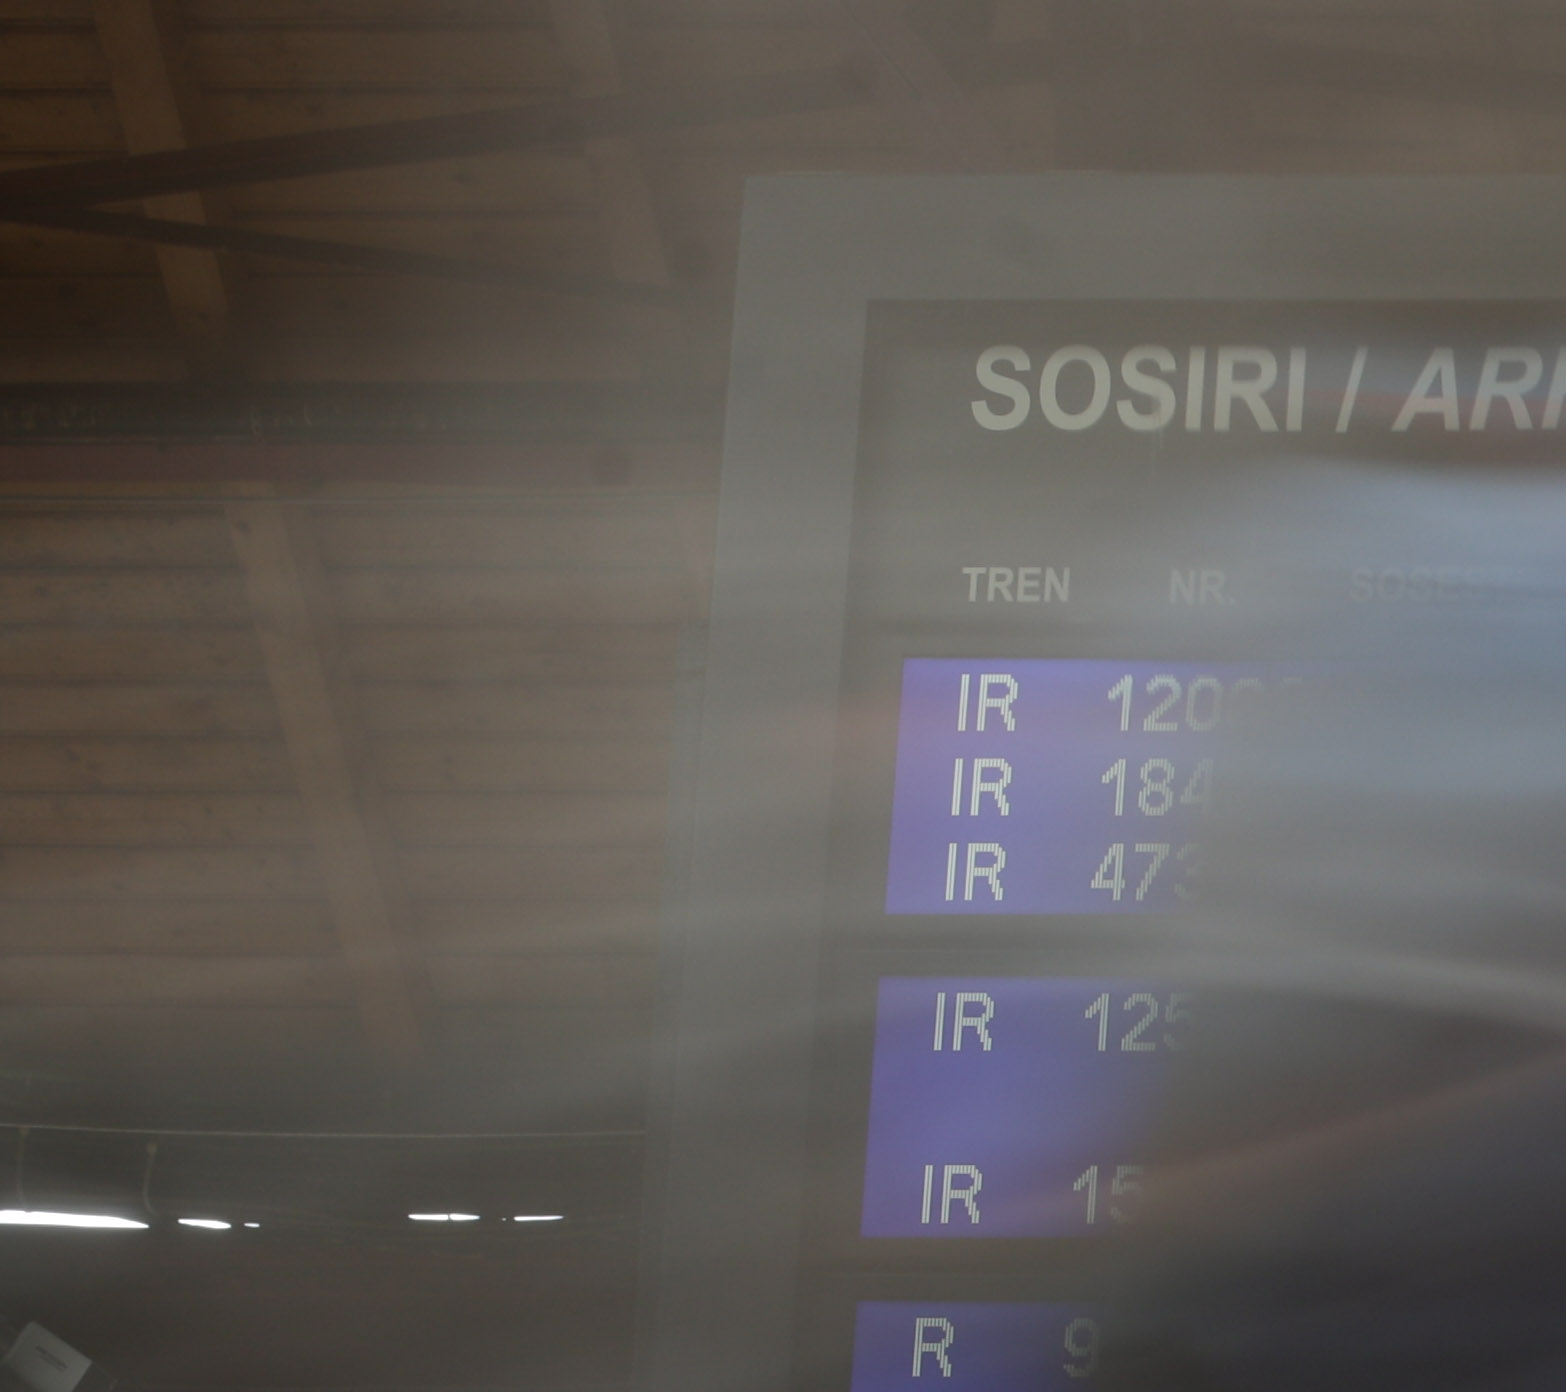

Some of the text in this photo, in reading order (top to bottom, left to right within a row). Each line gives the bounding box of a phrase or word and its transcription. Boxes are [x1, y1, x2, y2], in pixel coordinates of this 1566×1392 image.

[969, 344, 1307, 434] SOSIRI
[961, 566, 1071, 604] TREN
[957, 673, 1018, 732] IR
